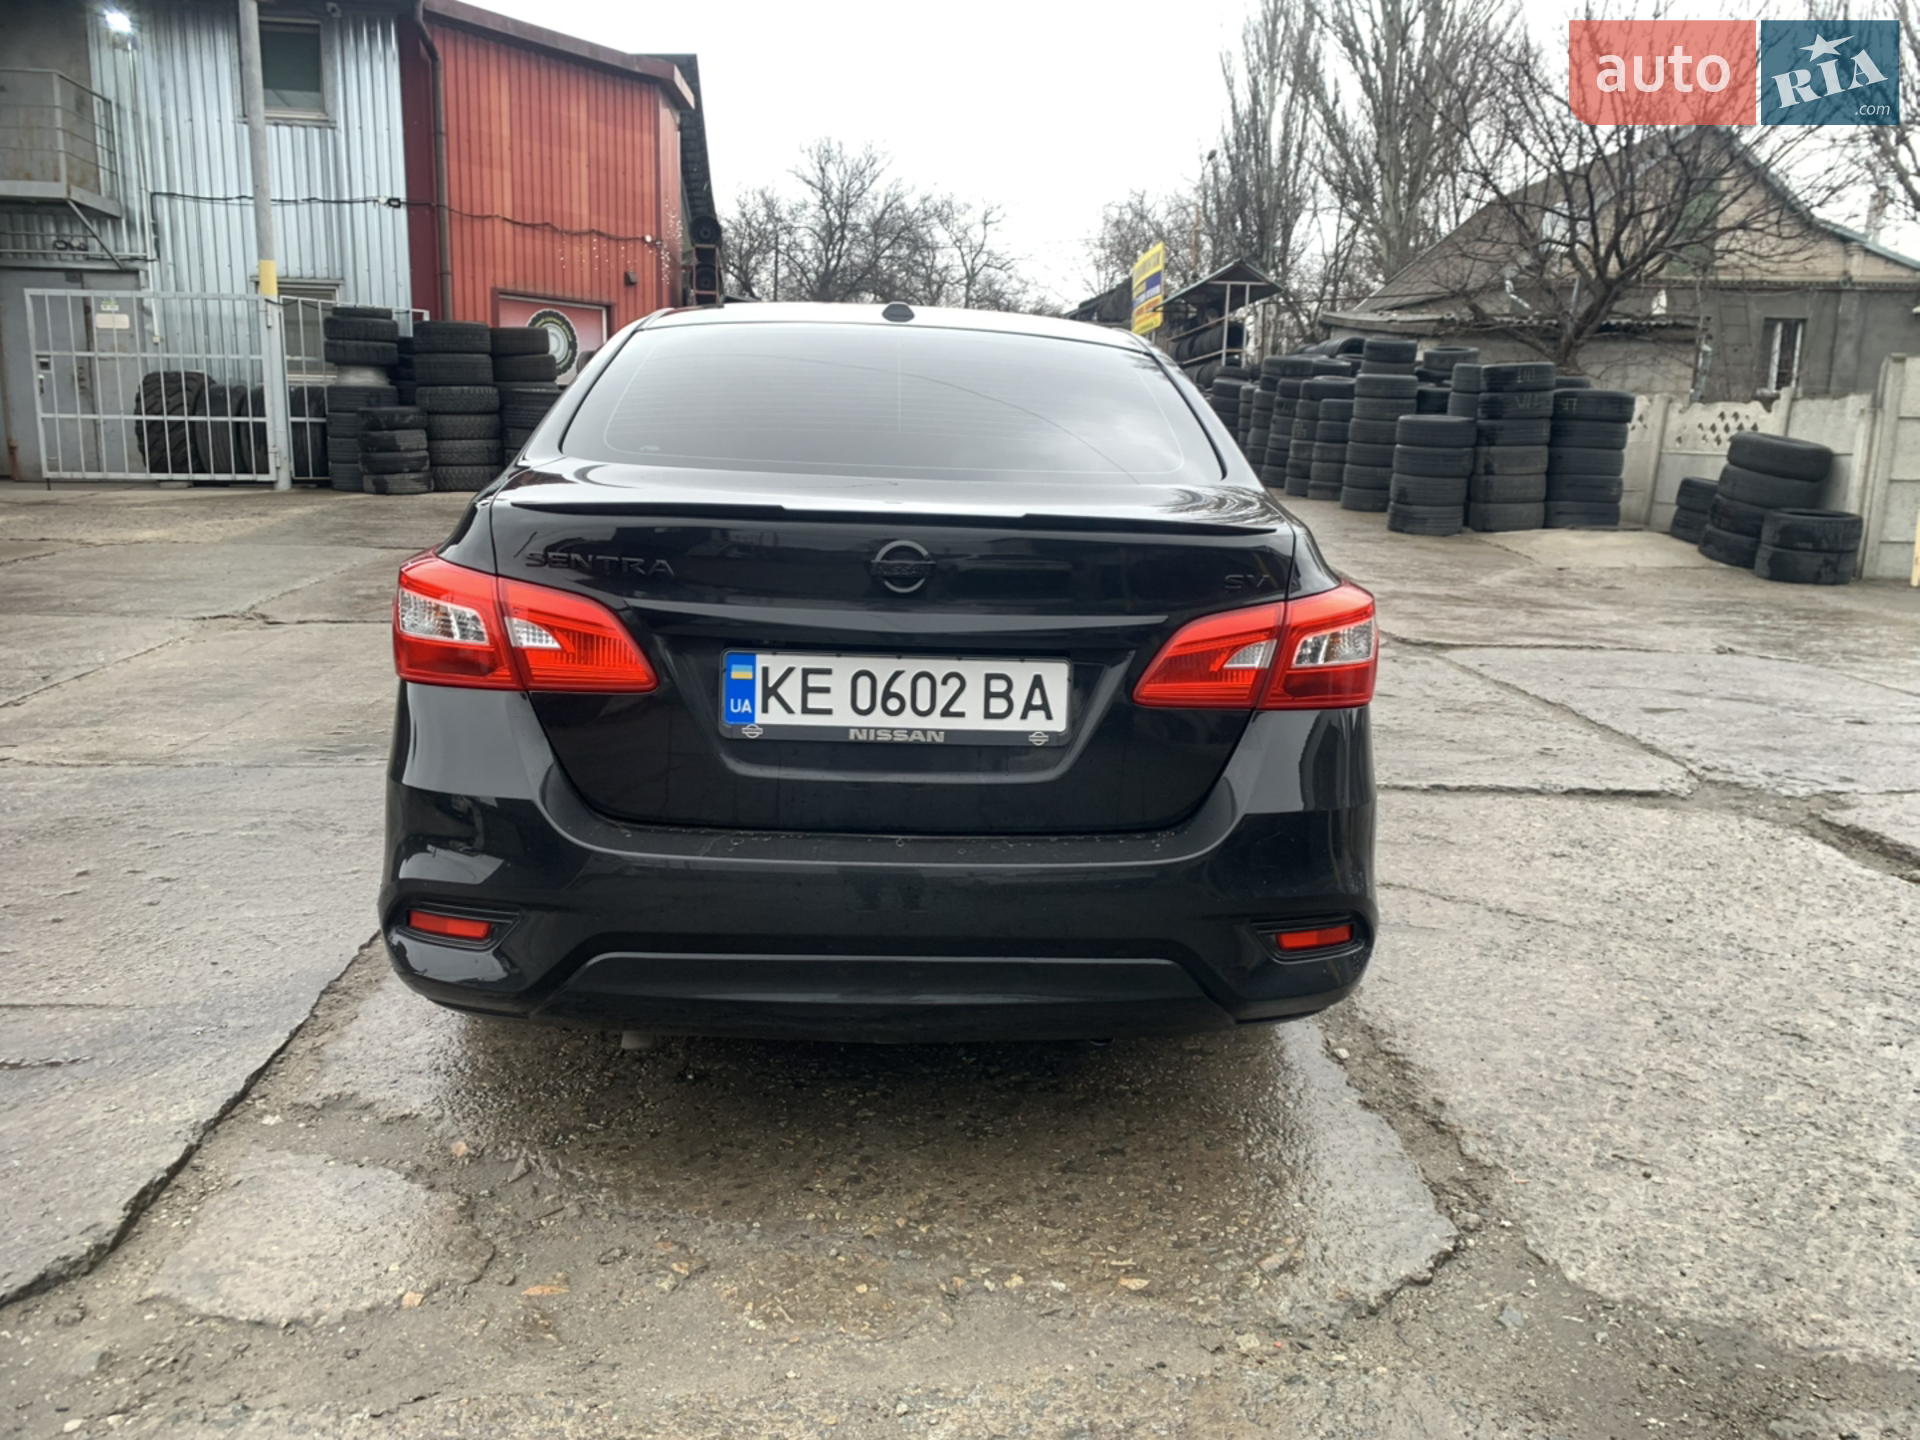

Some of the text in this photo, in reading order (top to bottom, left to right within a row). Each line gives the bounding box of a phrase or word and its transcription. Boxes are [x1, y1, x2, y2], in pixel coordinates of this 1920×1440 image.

[525, 551, 676, 576] SENTRA
[1224, 574, 1270, 589] SV
[761, 666, 1054, 720] KE 0602 BA
[730, 699, 752, 713] UA
[849, 728, 945, 743] NISSAN
